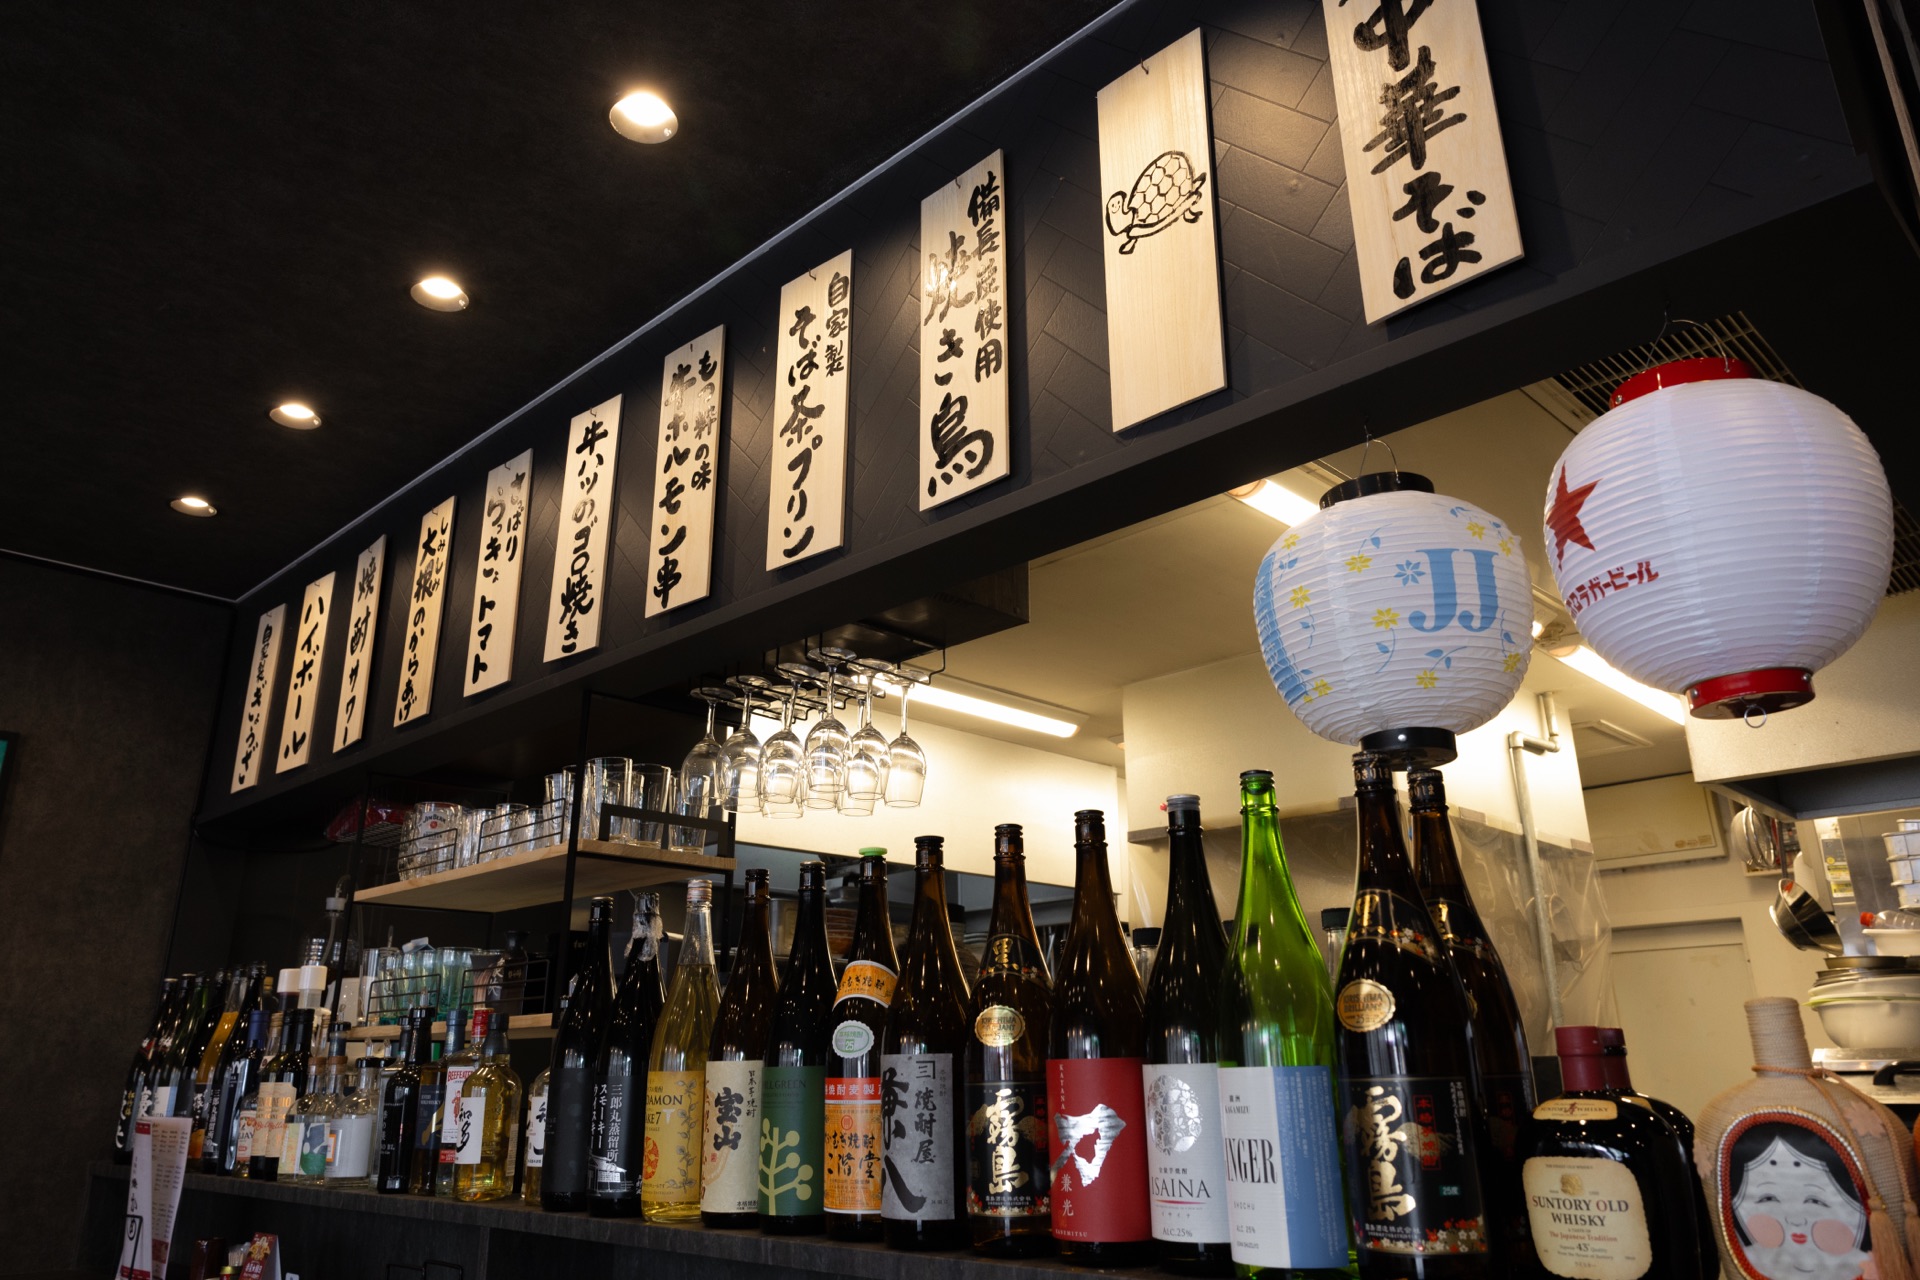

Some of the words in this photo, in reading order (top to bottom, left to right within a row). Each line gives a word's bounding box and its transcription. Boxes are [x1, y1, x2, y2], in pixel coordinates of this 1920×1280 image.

[1339, 0, 1487, 299] 中華そば
[967, 170, 1003, 383] 備長炭使用
[825, 271, 850, 378] 自家製
[924, 231, 994, 497] 焼き鳥
[780, 305, 826, 559] そば茶プリン
[505, 471, 526, 562] さっぱり
[653, 363, 697, 609] 牛ホルモン串
[559, 420, 609, 654] 牛ハツのゴロ焼き
[398, 526, 438, 722] 大根のからあげ
[1408, 548, 1499, 633] JJ
[284, 596, 325, 759] ハイボール
[343, 556, 377, 746] 焼酎サワー
[993, 937, 1019, 970] 黒
[845, 1040, 855, 1051] 25
[456, 1102, 473, 1154] 知多
[597, 1083, 608, 1149] スモーキー
[713, 1087, 744, 1151] 宝山
[911, 1089, 937, 1164] 焼酎屋
[985, 1088, 1030, 1196] 霧島
[1050, 1103, 1127, 1188] 刀
[1359, 1084, 1417, 1222] 霧島
[827, 1150, 881, 1179] 二階堂
[1060, 1173, 1075, 1217] 兼光
[1151, 1176, 1211, 1199] ISAINA
[1531, 1194, 1592, 1212] SUNTORY
[1595, 1199, 1630, 1213] OLD
[1550, 1212, 1607, 1227] WHISKY
[1560, 1232, 1585, 1242] Japanese
[1587, 1234, 1618, 1242] Tradition
